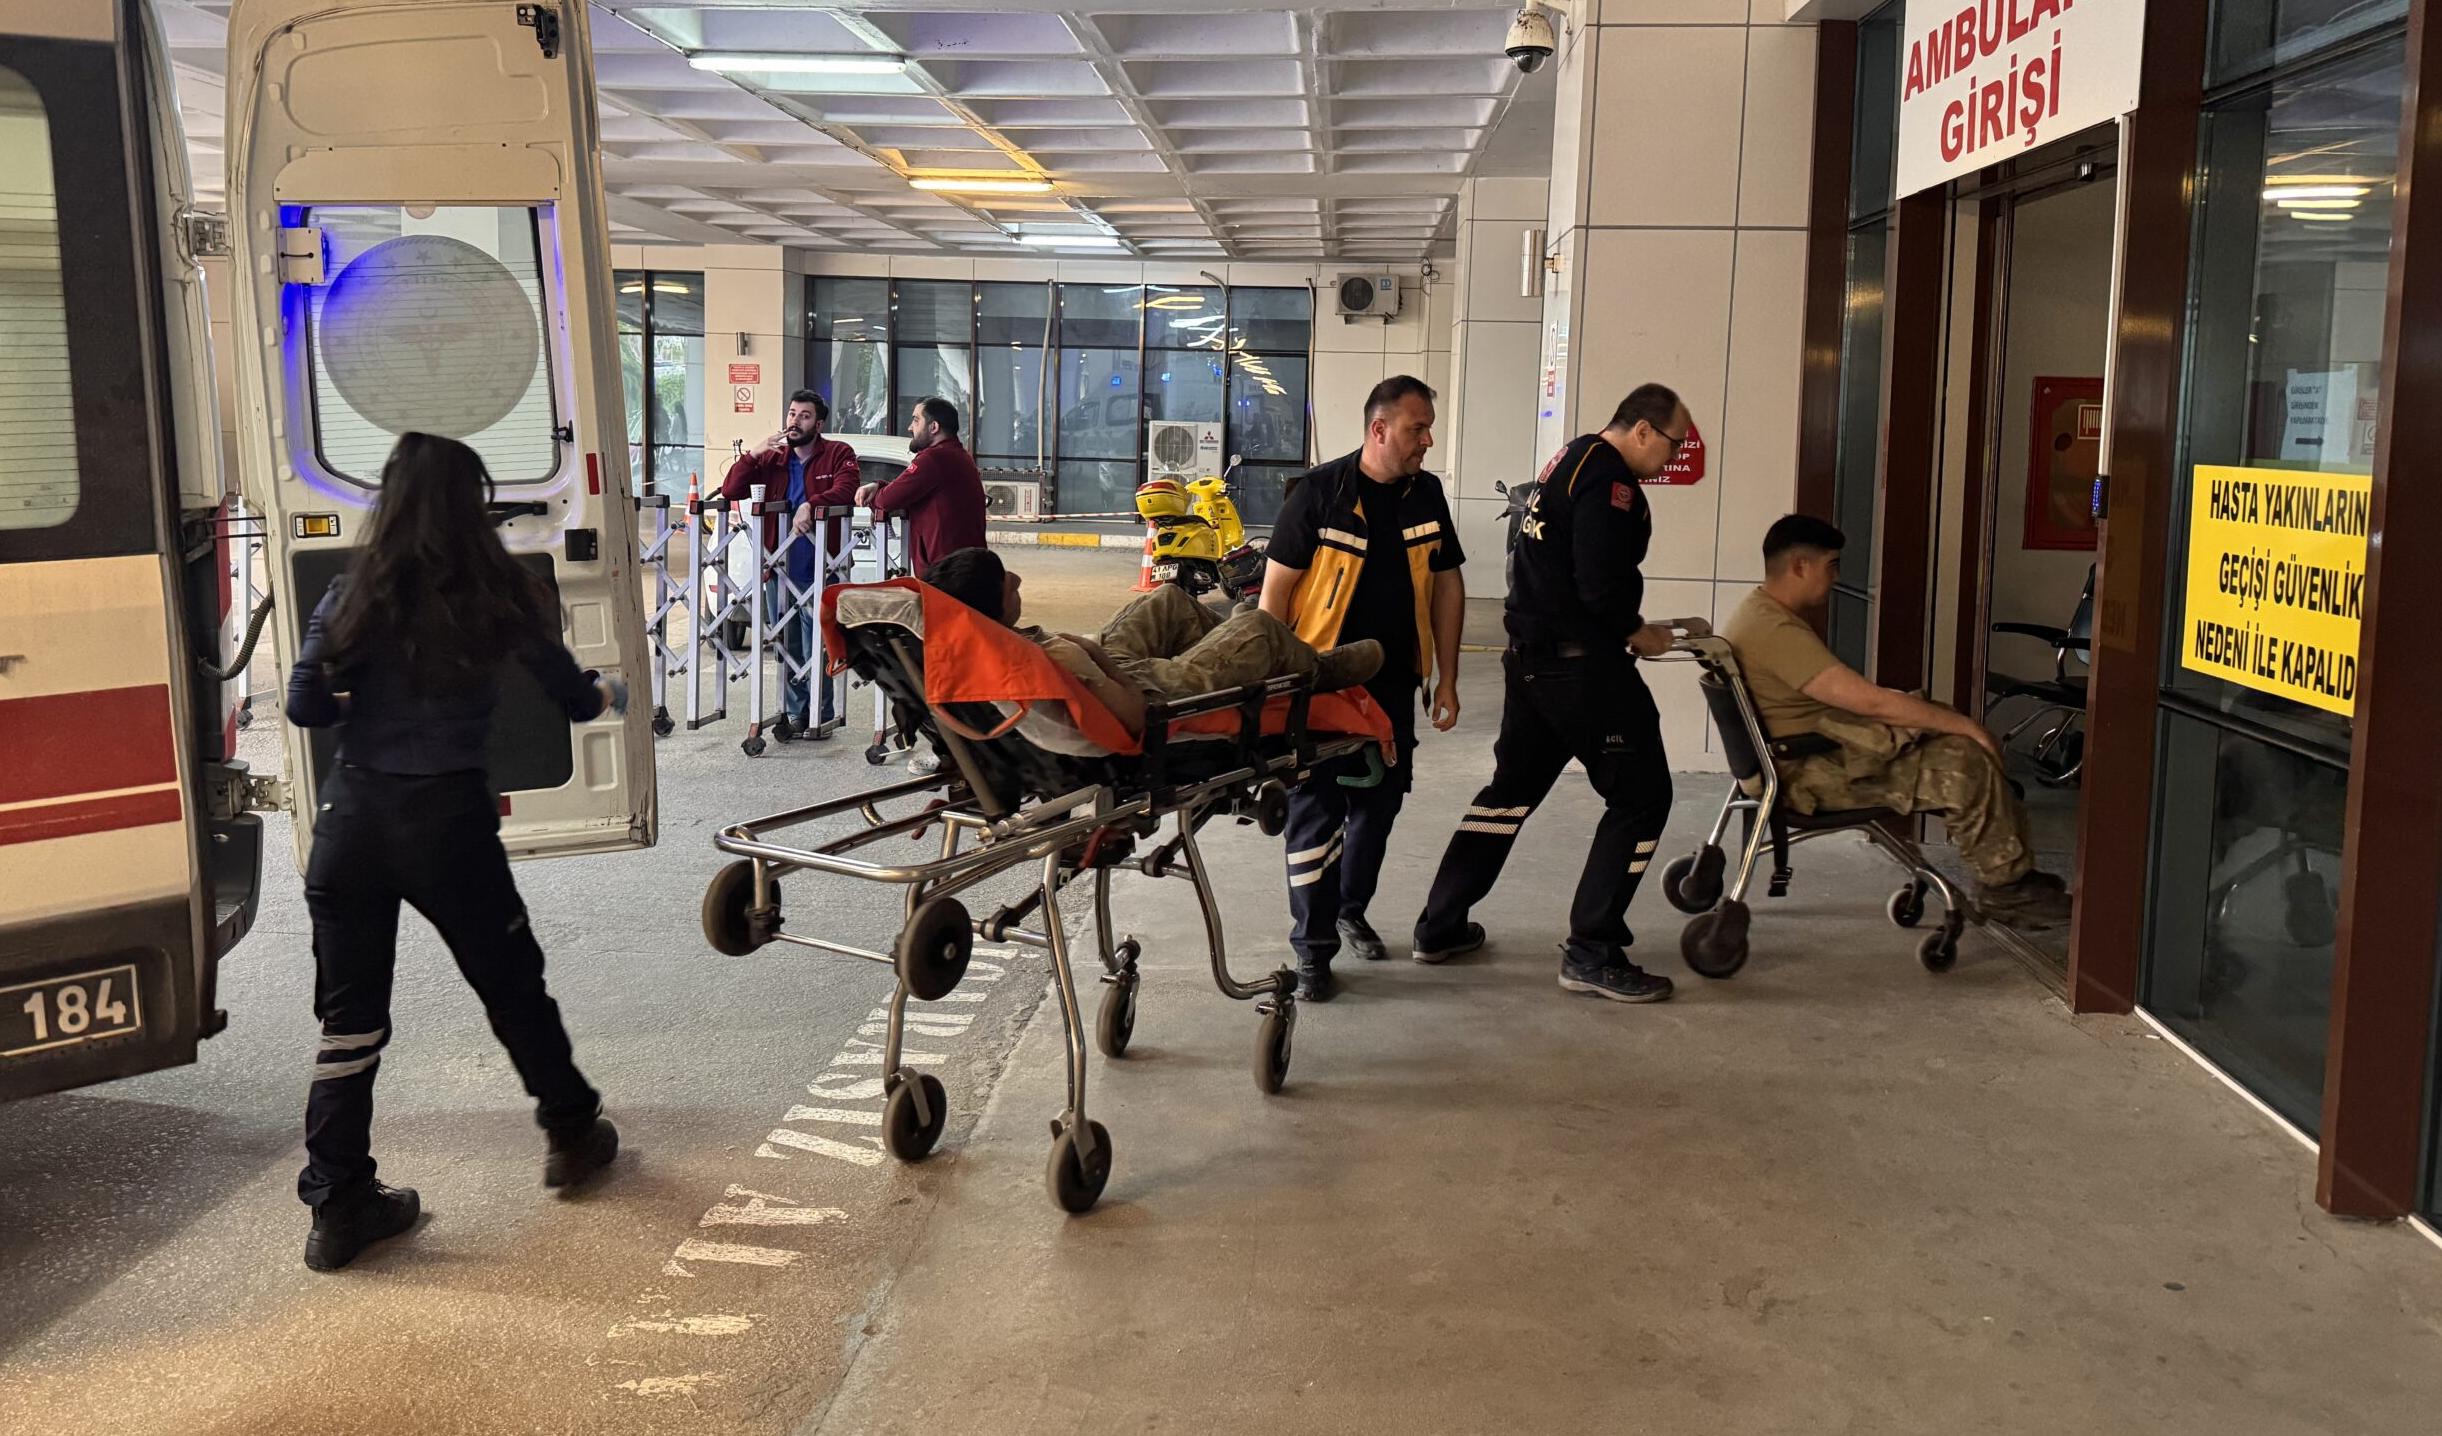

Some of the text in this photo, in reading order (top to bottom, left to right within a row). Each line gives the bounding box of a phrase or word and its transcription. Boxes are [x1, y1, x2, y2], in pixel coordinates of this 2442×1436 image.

[1904, 0, 2074, 102] AMBUL
[1940, 28, 2062, 163] GİRİŞİ
[2210, 479, 2258, 524] HASTA
[2219, 546, 2364, 620] GEÇİŞİ GÜVENLİK
[2195, 619, 2355, 701] NEDENİ İLE KAPALID
[24, 978, 126, 1040] 184
